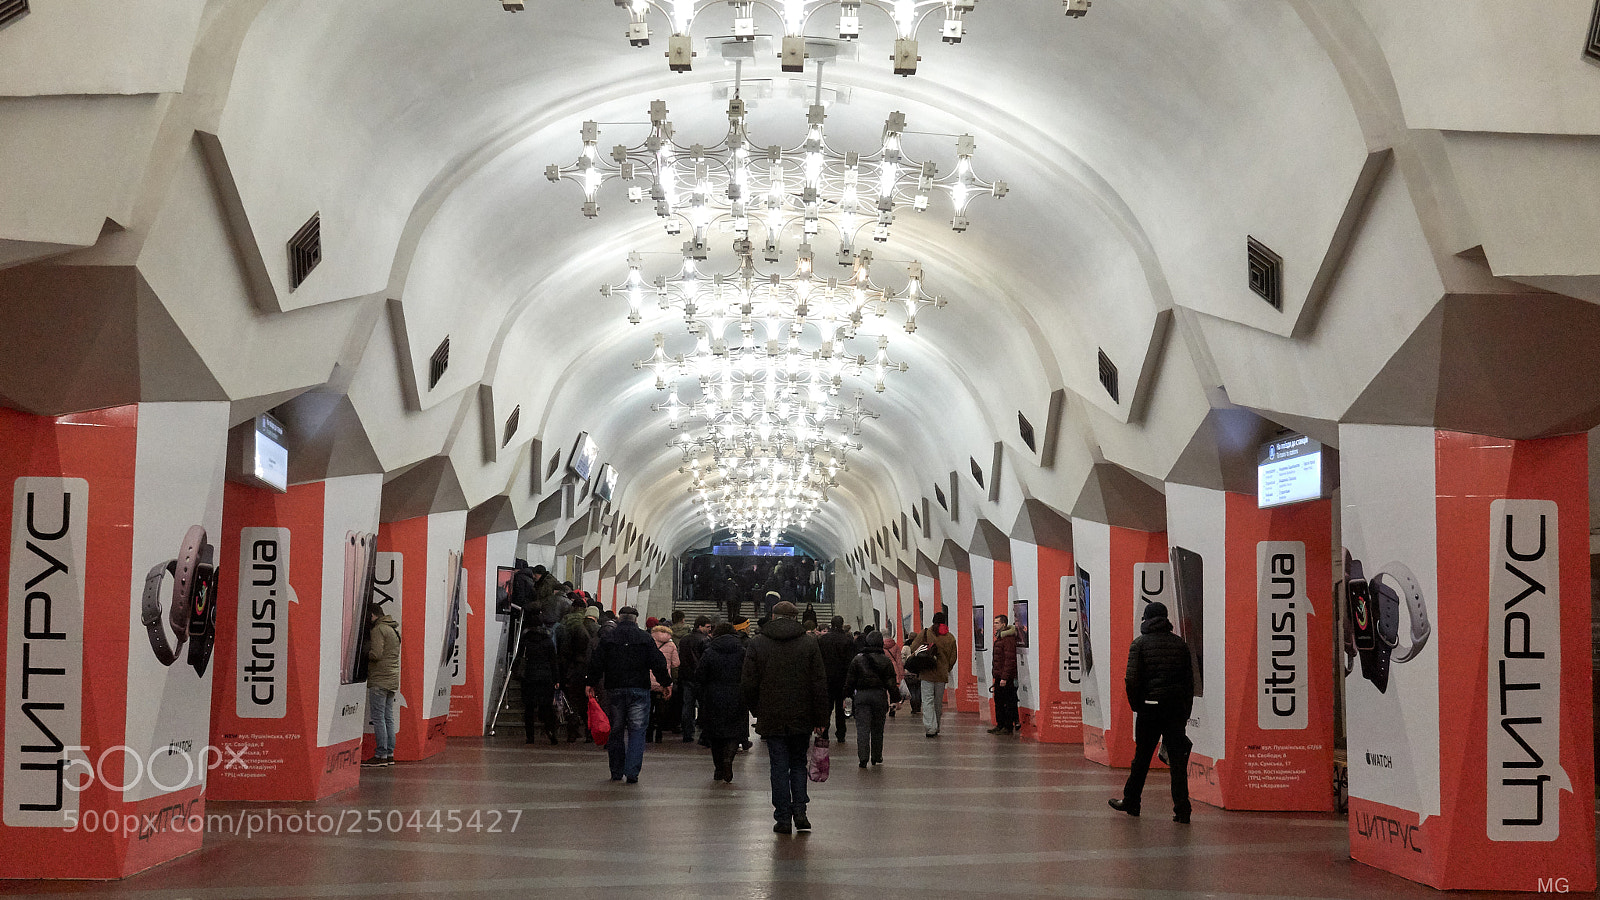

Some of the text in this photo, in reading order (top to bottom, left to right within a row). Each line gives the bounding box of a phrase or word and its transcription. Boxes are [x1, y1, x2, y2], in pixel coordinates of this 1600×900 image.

[20, 492, 71, 811] ЦИТРУС
[244, 539, 278, 706] citrus.ua
[1264, 553, 1296, 717] citrus.ua
[1499, 514, 1551, 826] ЦИТРУС
[139, 798, 199, 842] ЦИТРУС
[1356, 810, 1422, 853] ЦИТРУС
[1370, 752, 1393, 769] WATCH
